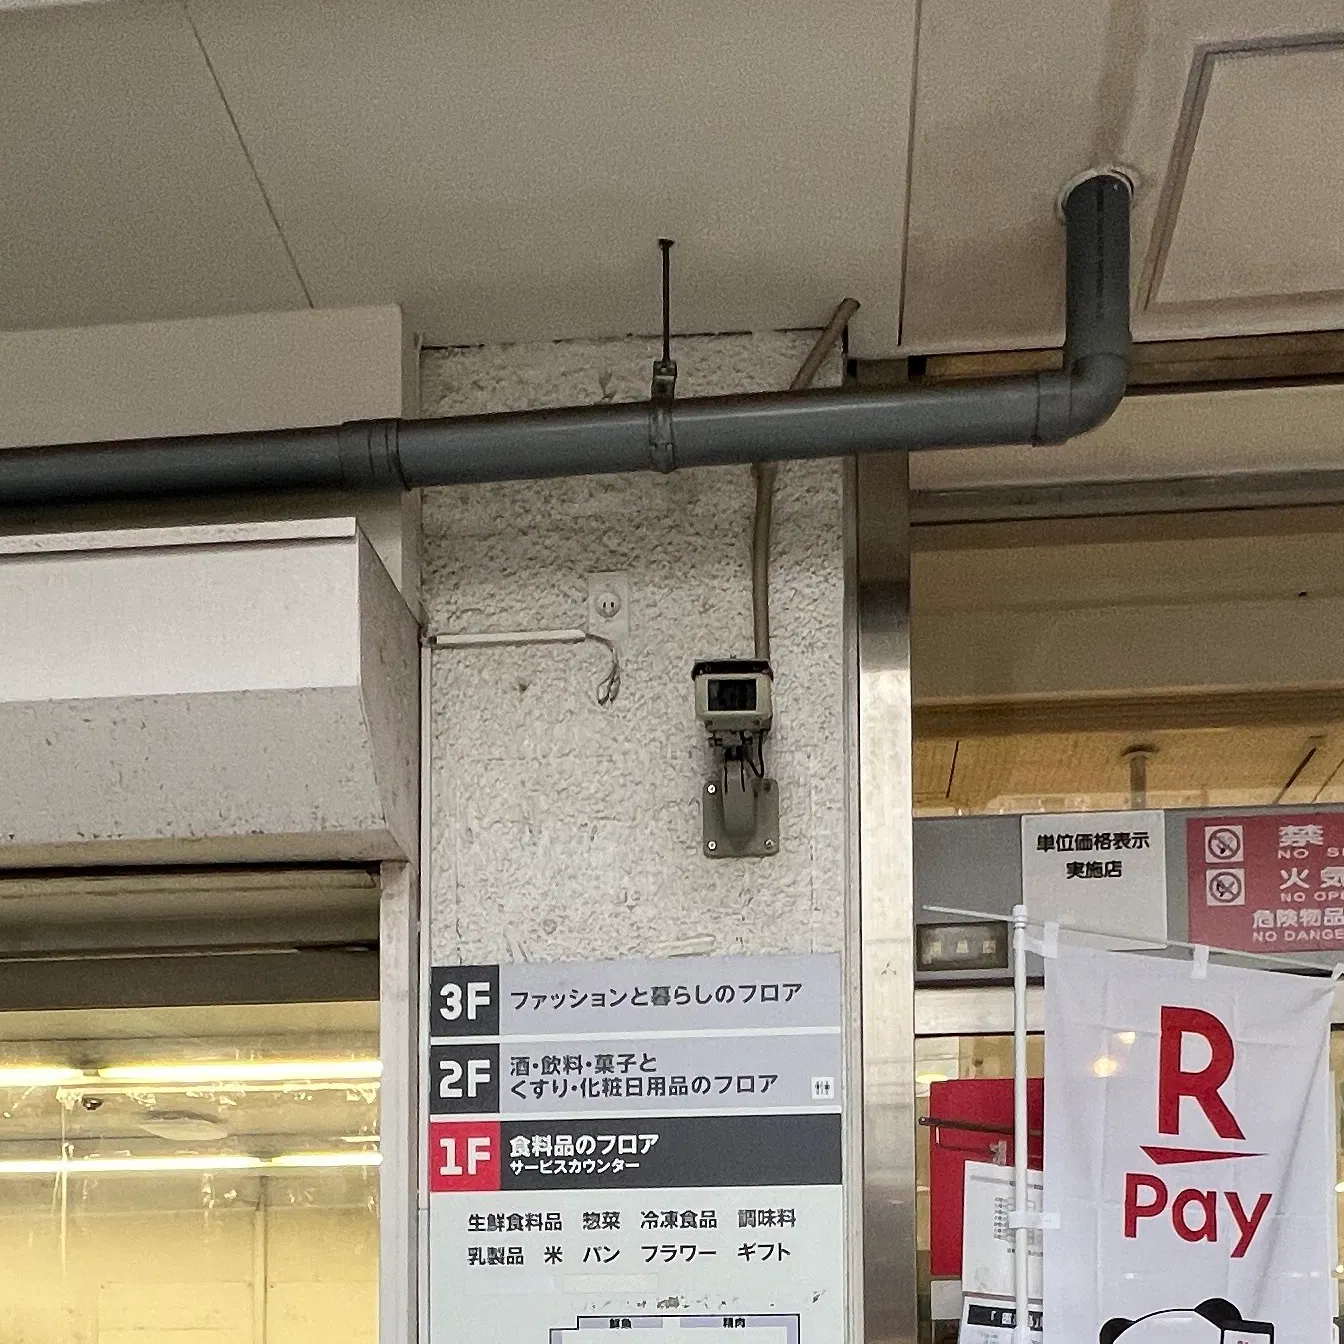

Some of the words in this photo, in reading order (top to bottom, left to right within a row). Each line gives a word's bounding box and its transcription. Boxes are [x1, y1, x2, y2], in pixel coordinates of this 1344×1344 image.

[1037, 832, 1150, 853] 単位価格表示
[1277, 848, 1309, 860] NO
[1066, 860, 1123, 880] 実施店
[1280, 891, 1306, 902] NO
[1253, 930, 1277, 942] NO
[439, 981, 492, 1020] 3F
[510, 983, 804, 1012] ファッションと暮らしのフロア
[438, 1059, 492, 1099] 2F
[510, 1052, 657, 1076] 酒・飲料・菓子と
[1158, 1005, 1248, 1141] R
[510, 1073, 780, 1100] くすり・化粧日用品のフロア
[439, 1136, 492, 1176] 1F
[509, 1133, 660, 1158] 食料品のフロア
[510, 1159, 641, 1176] サービスカウンター
[467, 1211, 564, 1233] 生鮮食料品
[582, 1210, 622, 1231] 惣菜
[640, 1209, 719, 1230] 冷凍食品
[737, 1208, 797, 1229] 調味料
[1123, 1173, 1273, 1259] Pay
[467, 1246, 525, 1266] 乳製品
[544, 1246, 564, 1265] 米
[582, 1245, 621, 1264] パン
[640, 1245, 718, 1264] フラワー
[737, 1242, 792, 1262] ギフト
[723, 1317, 746, 1328] 精肉
